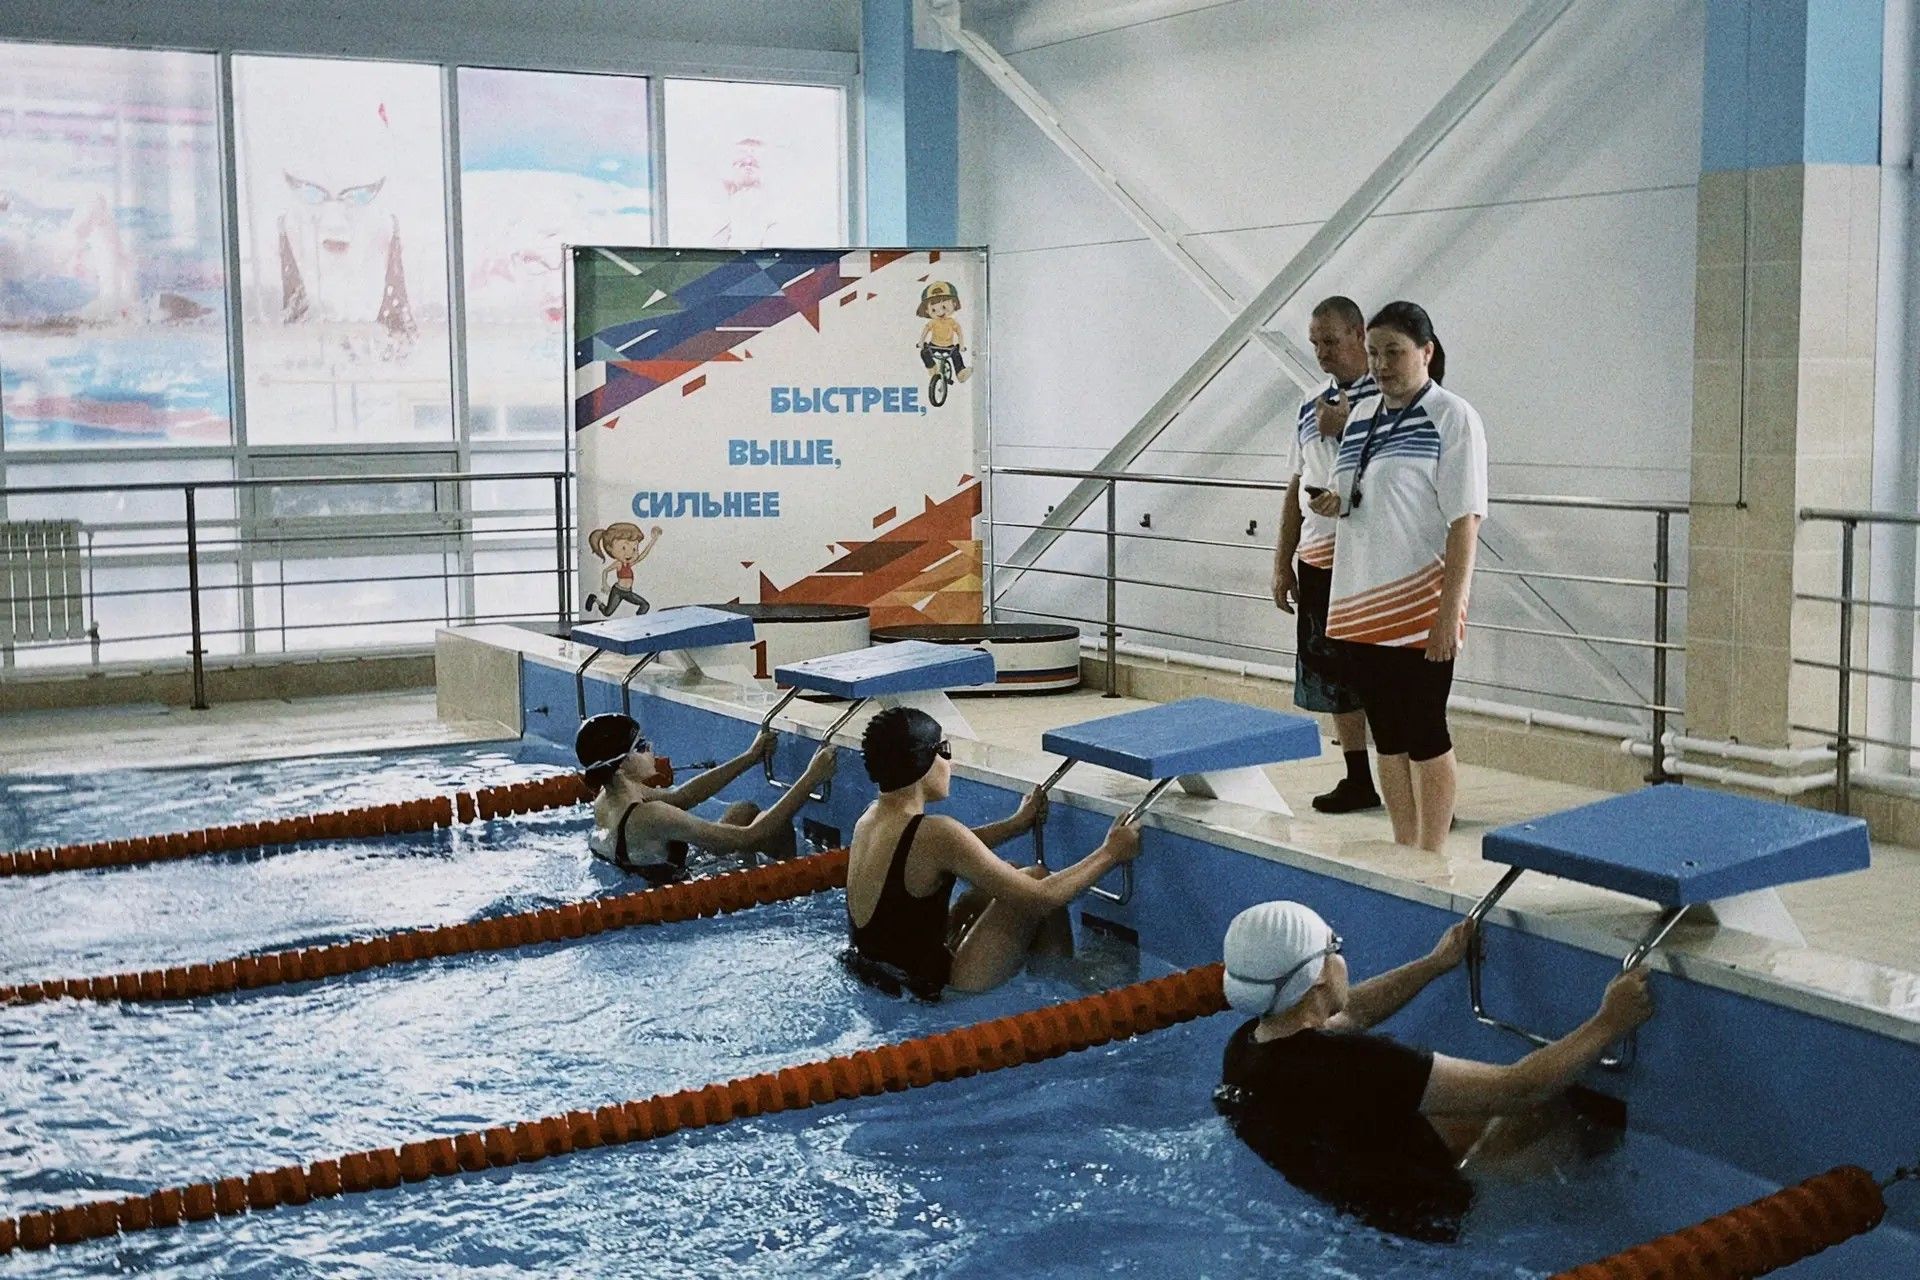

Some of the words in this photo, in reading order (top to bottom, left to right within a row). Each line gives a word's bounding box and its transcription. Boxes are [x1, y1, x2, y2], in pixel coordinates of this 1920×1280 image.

[770, 386, 927, 417] БЫСТРЕЕ,
[728, 439, 842, 469] ВЫШЕ,
[631, 491, 780, 518] СИЛЬНЕЕ
[749, 640, 772, 679] 1
